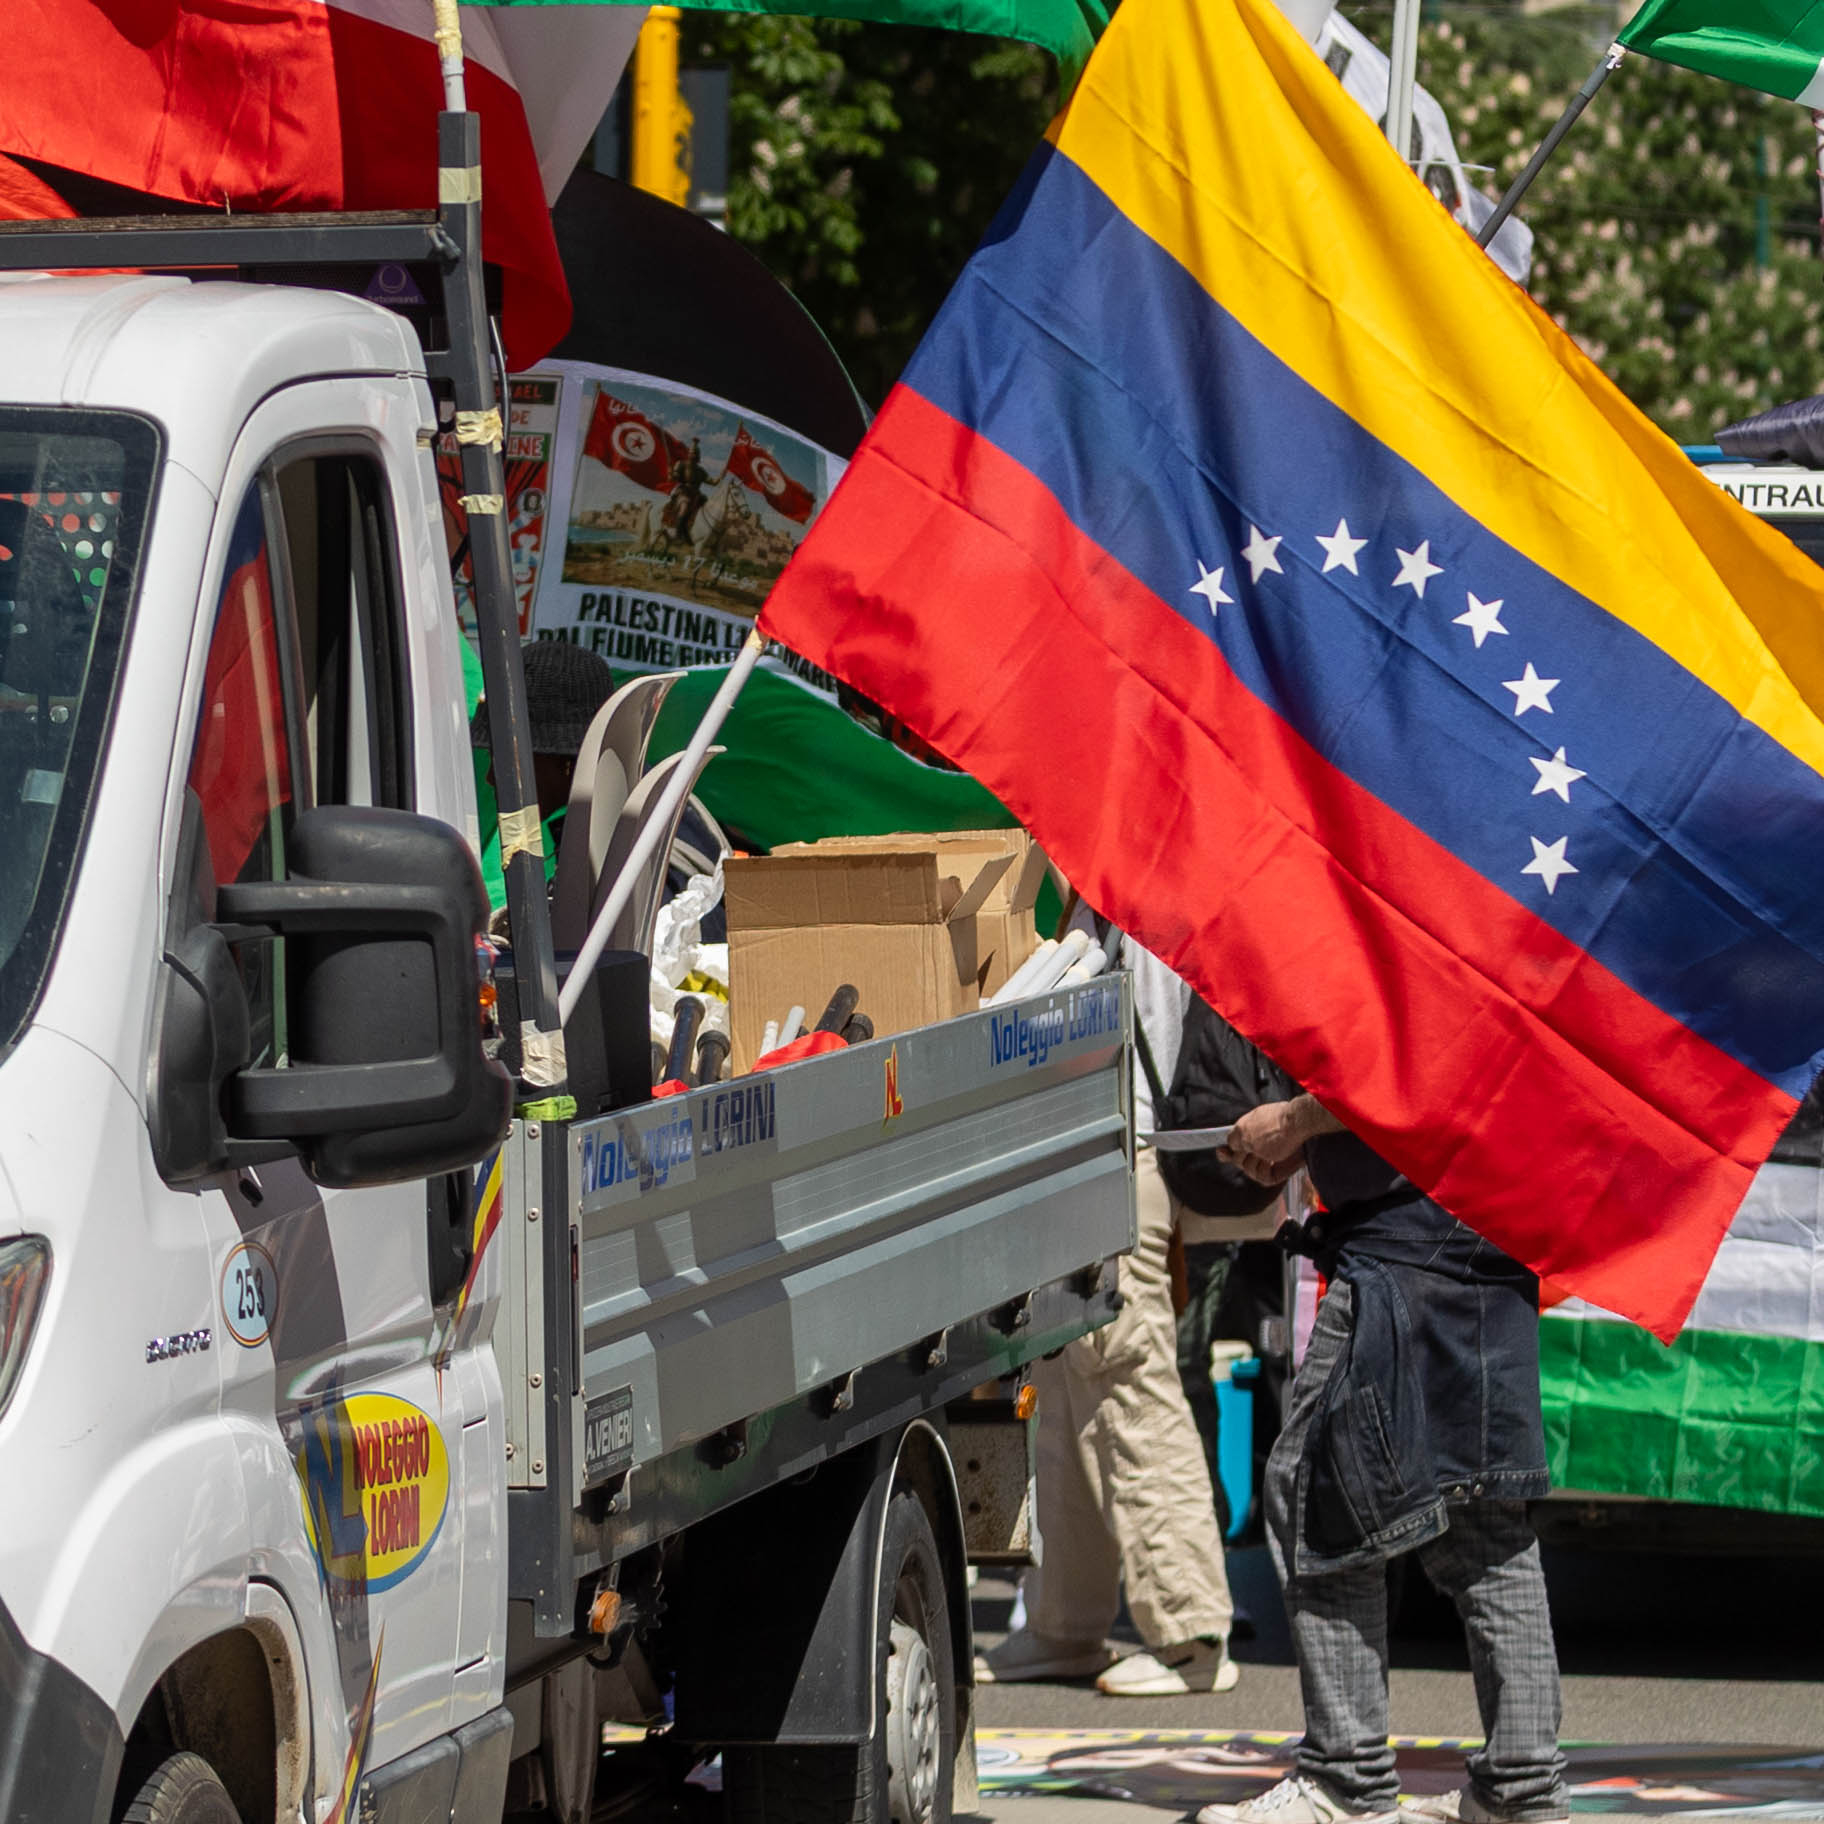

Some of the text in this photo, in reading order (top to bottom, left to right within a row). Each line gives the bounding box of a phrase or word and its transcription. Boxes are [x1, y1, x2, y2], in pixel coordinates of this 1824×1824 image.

[577, 592, 717, 647] PALESTINA
[592, 627, 675, 667] FIUME
[990, 998, 1065, 1069] Noleggio
[581, 1082, 777, 1196] Noleggio LORINI
[236, 1267, 265, 1320] 253
[351, 1415, 430, 1490] NOLEGGIO
[370, 1484, 420, 1557] LORINI
